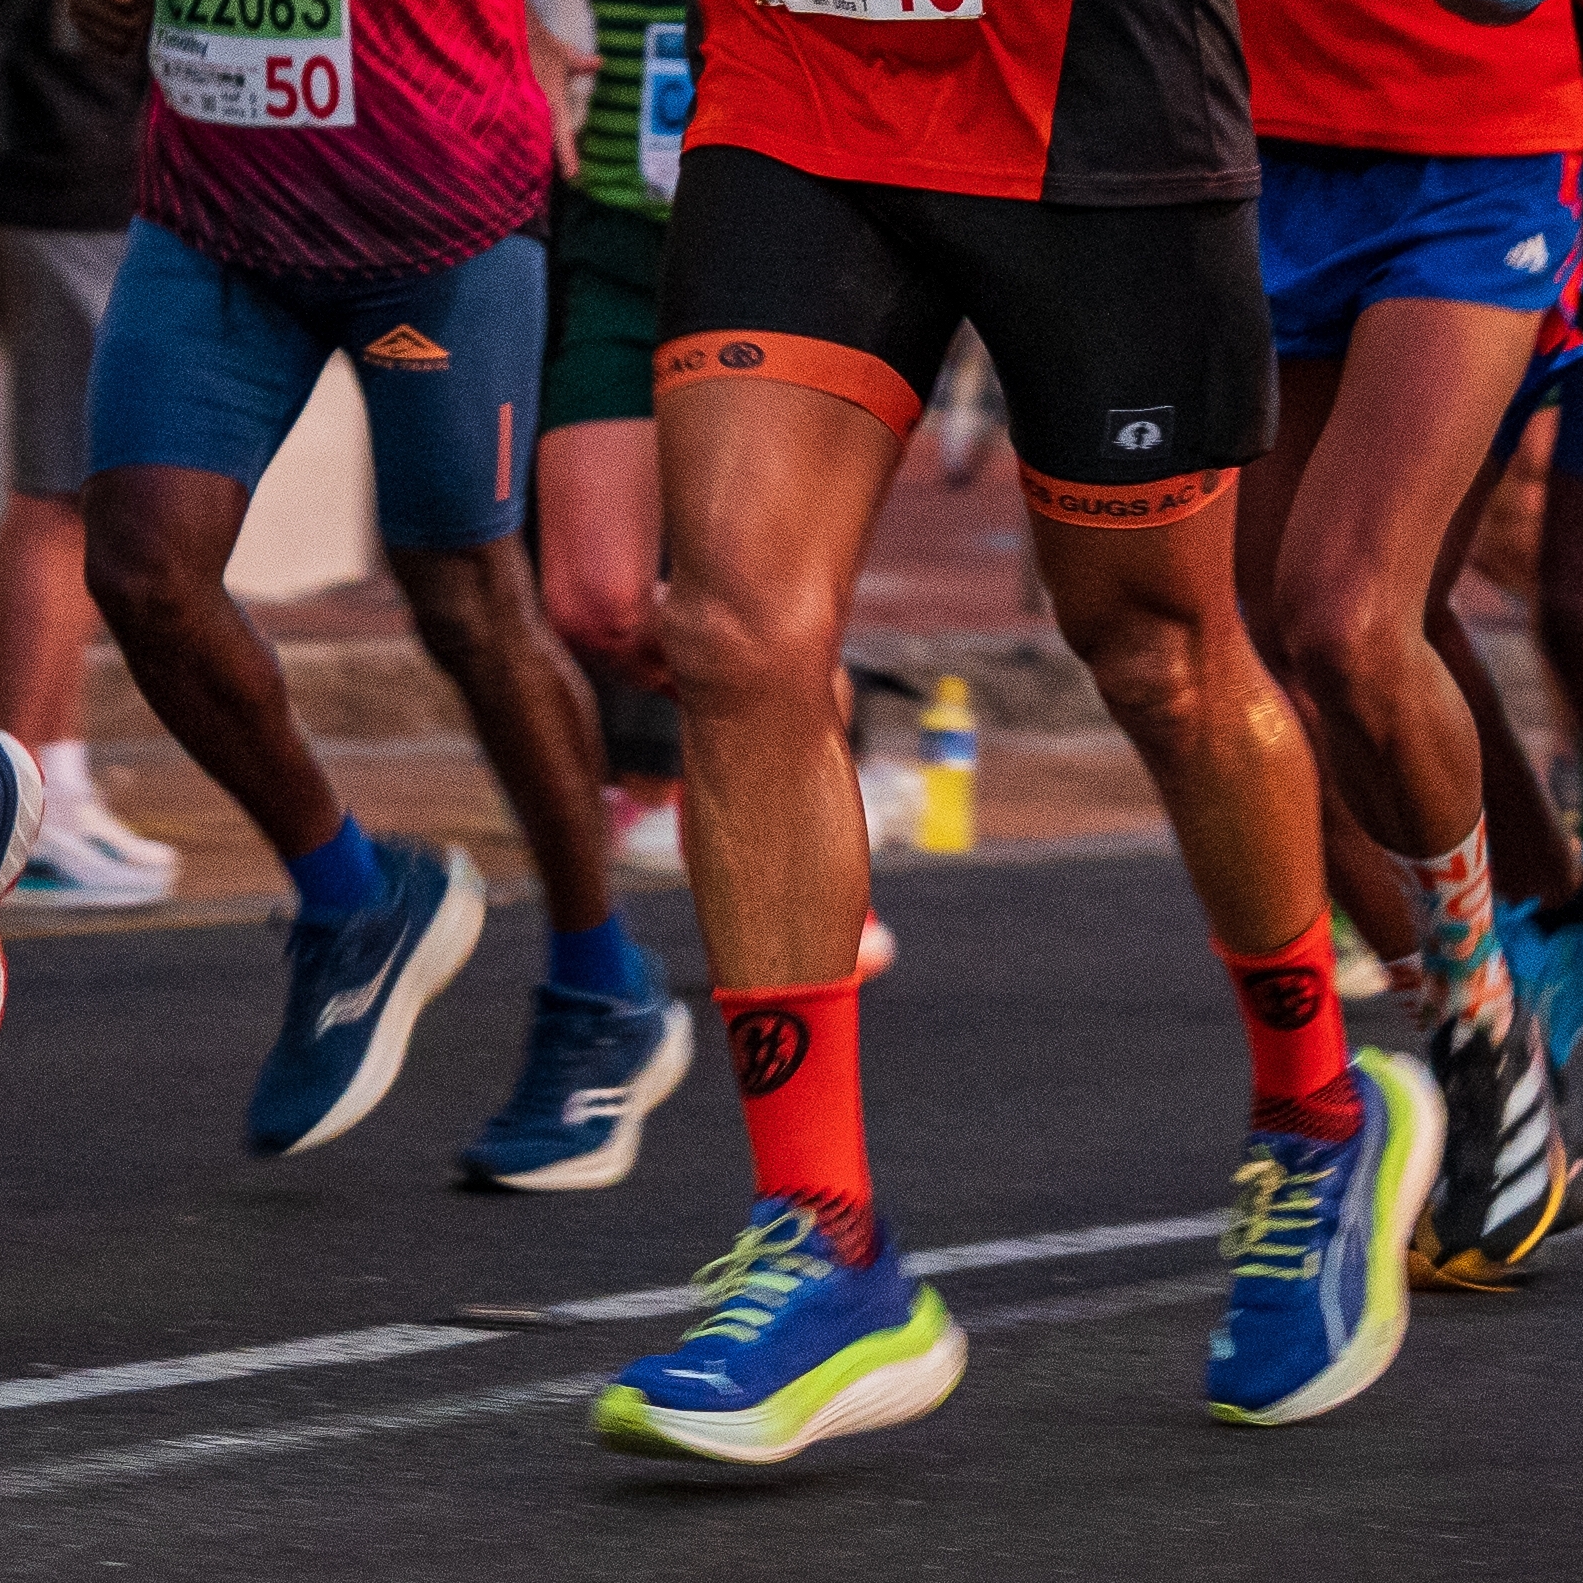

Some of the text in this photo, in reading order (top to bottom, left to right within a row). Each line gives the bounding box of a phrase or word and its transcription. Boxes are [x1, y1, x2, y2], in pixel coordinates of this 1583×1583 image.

[264, 54, 340, 120] 50
[1057, 493, 1150, 518] GUGS
[1157, 484, 1196, 513] AC
